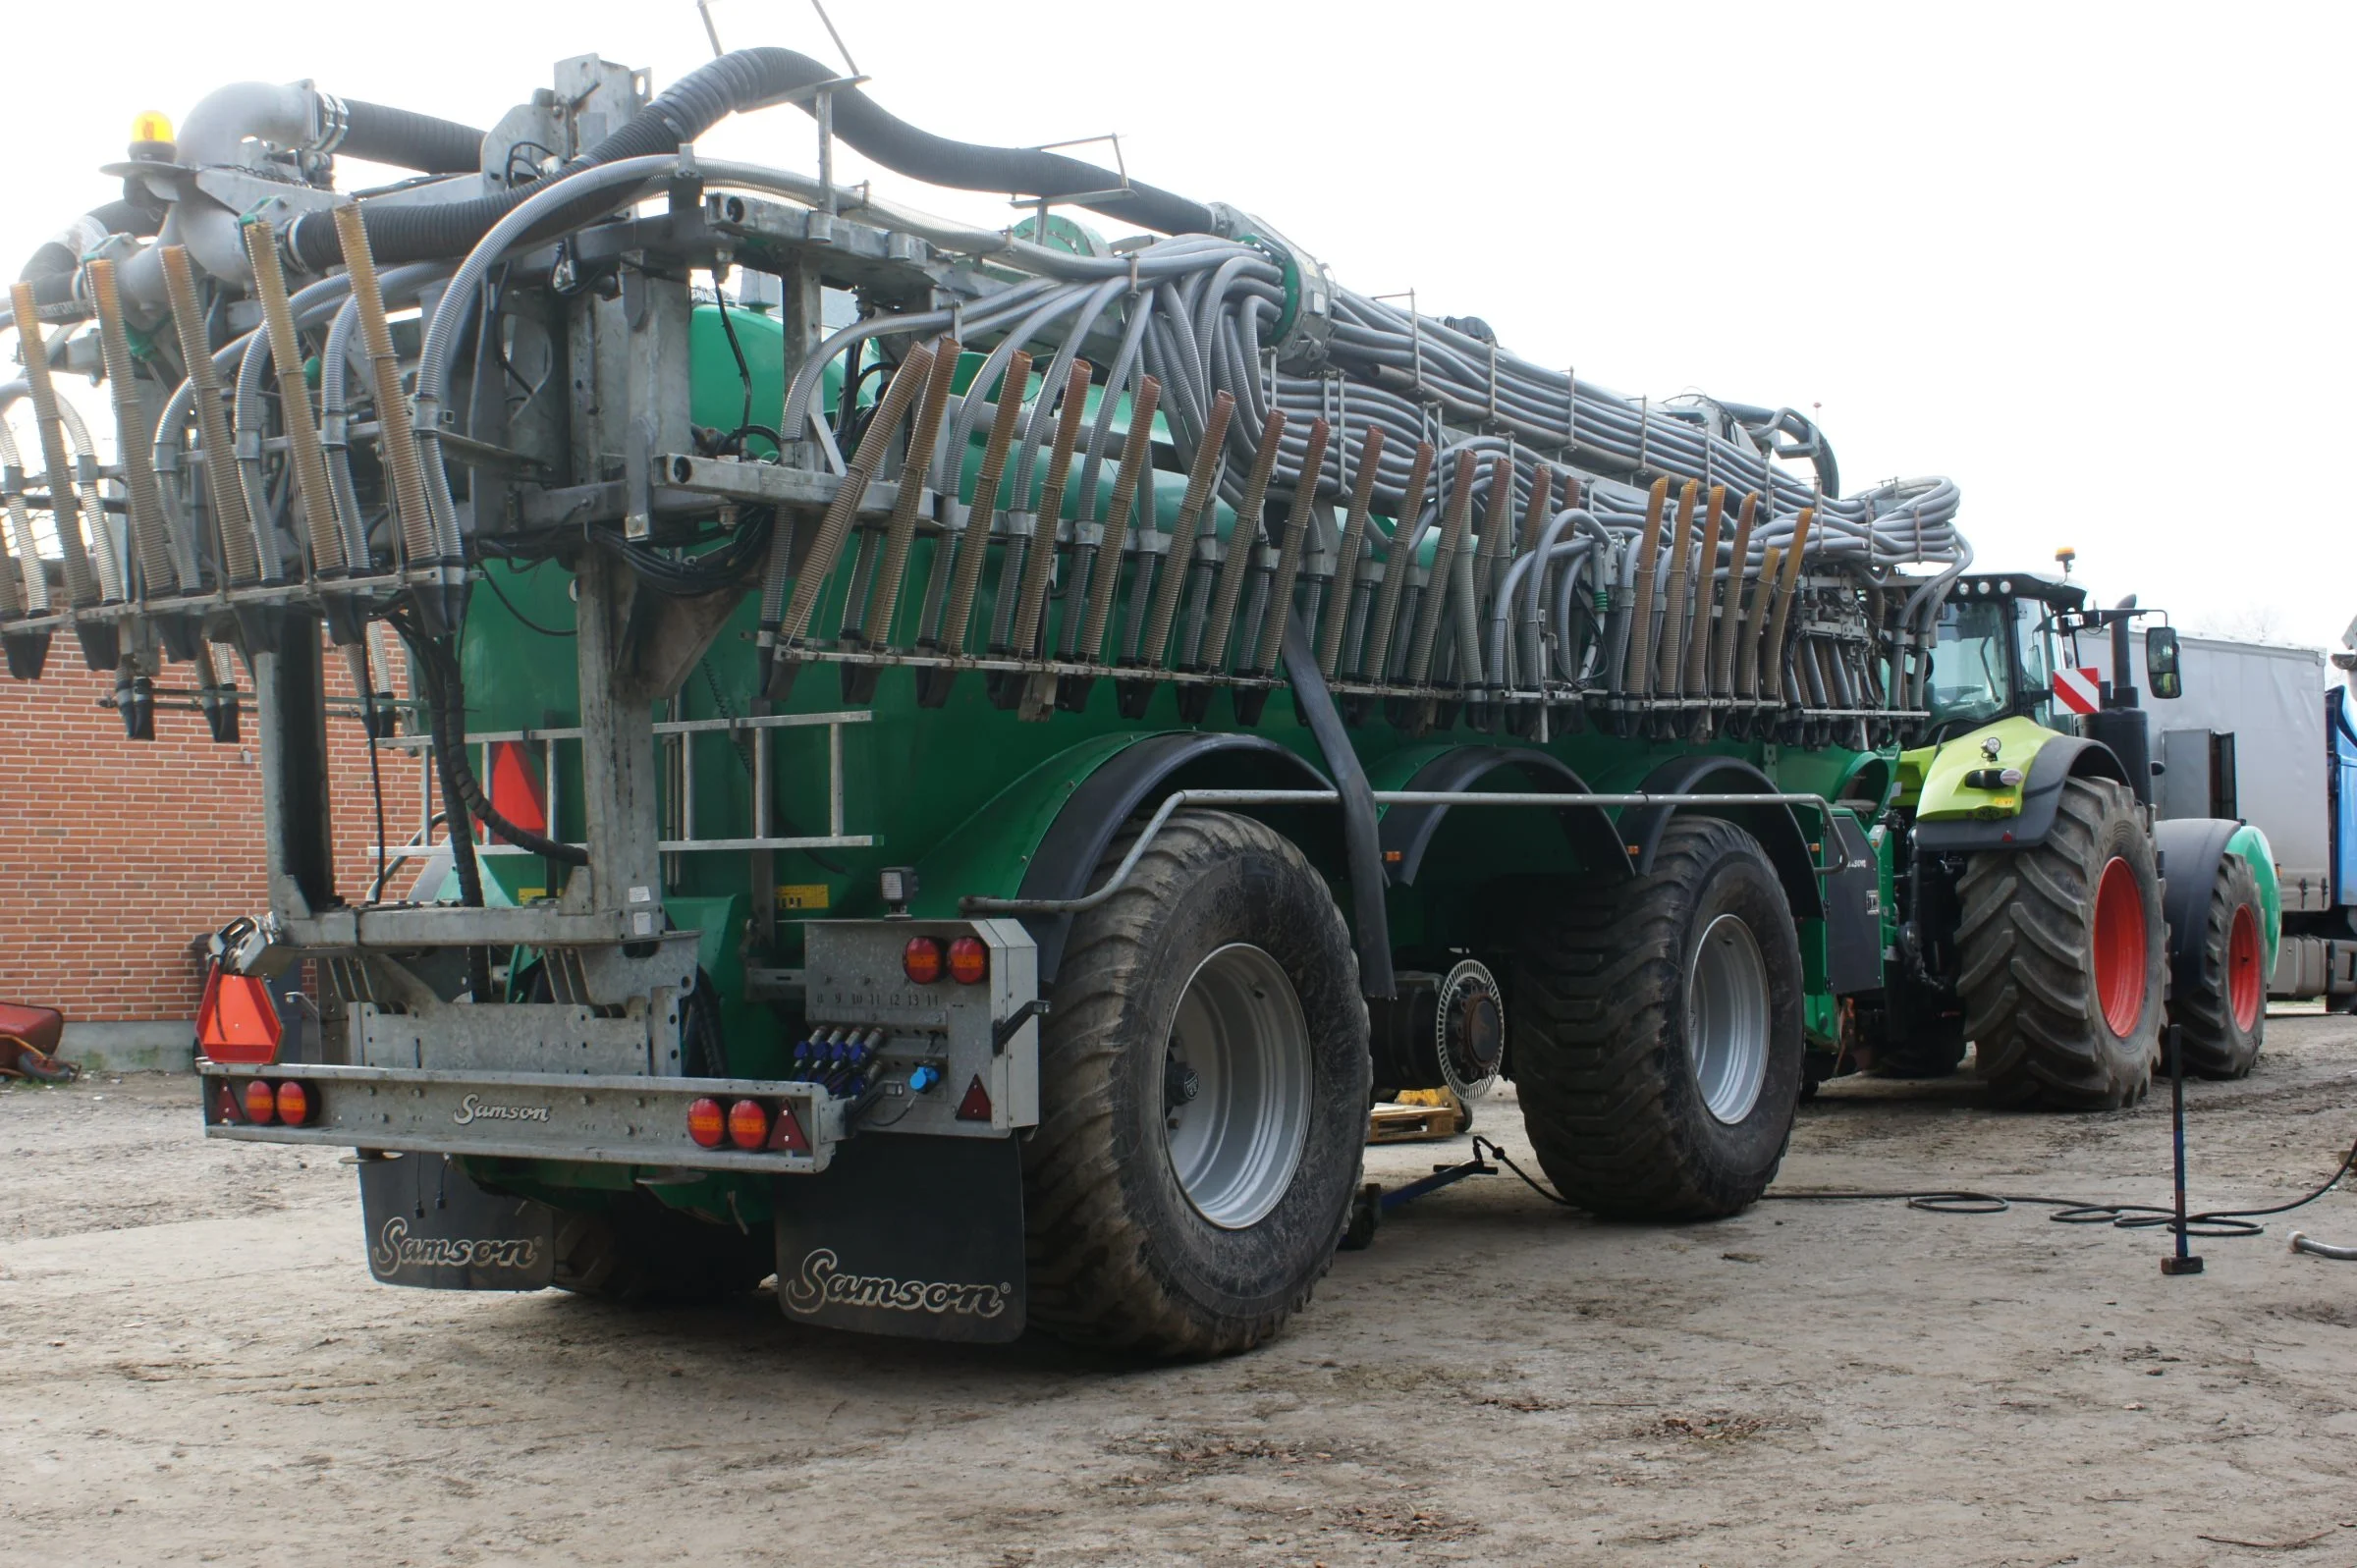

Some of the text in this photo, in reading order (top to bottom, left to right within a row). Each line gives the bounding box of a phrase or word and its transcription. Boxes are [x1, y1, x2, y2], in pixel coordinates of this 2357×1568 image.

[835, 993, 842, 1003] 9
[870, 993, 880, 1005] 11
[890, 994, 901, 1005] 12
[907, 994, 919, 1006] 13
[454, 1093, 550, 1125] Samson
